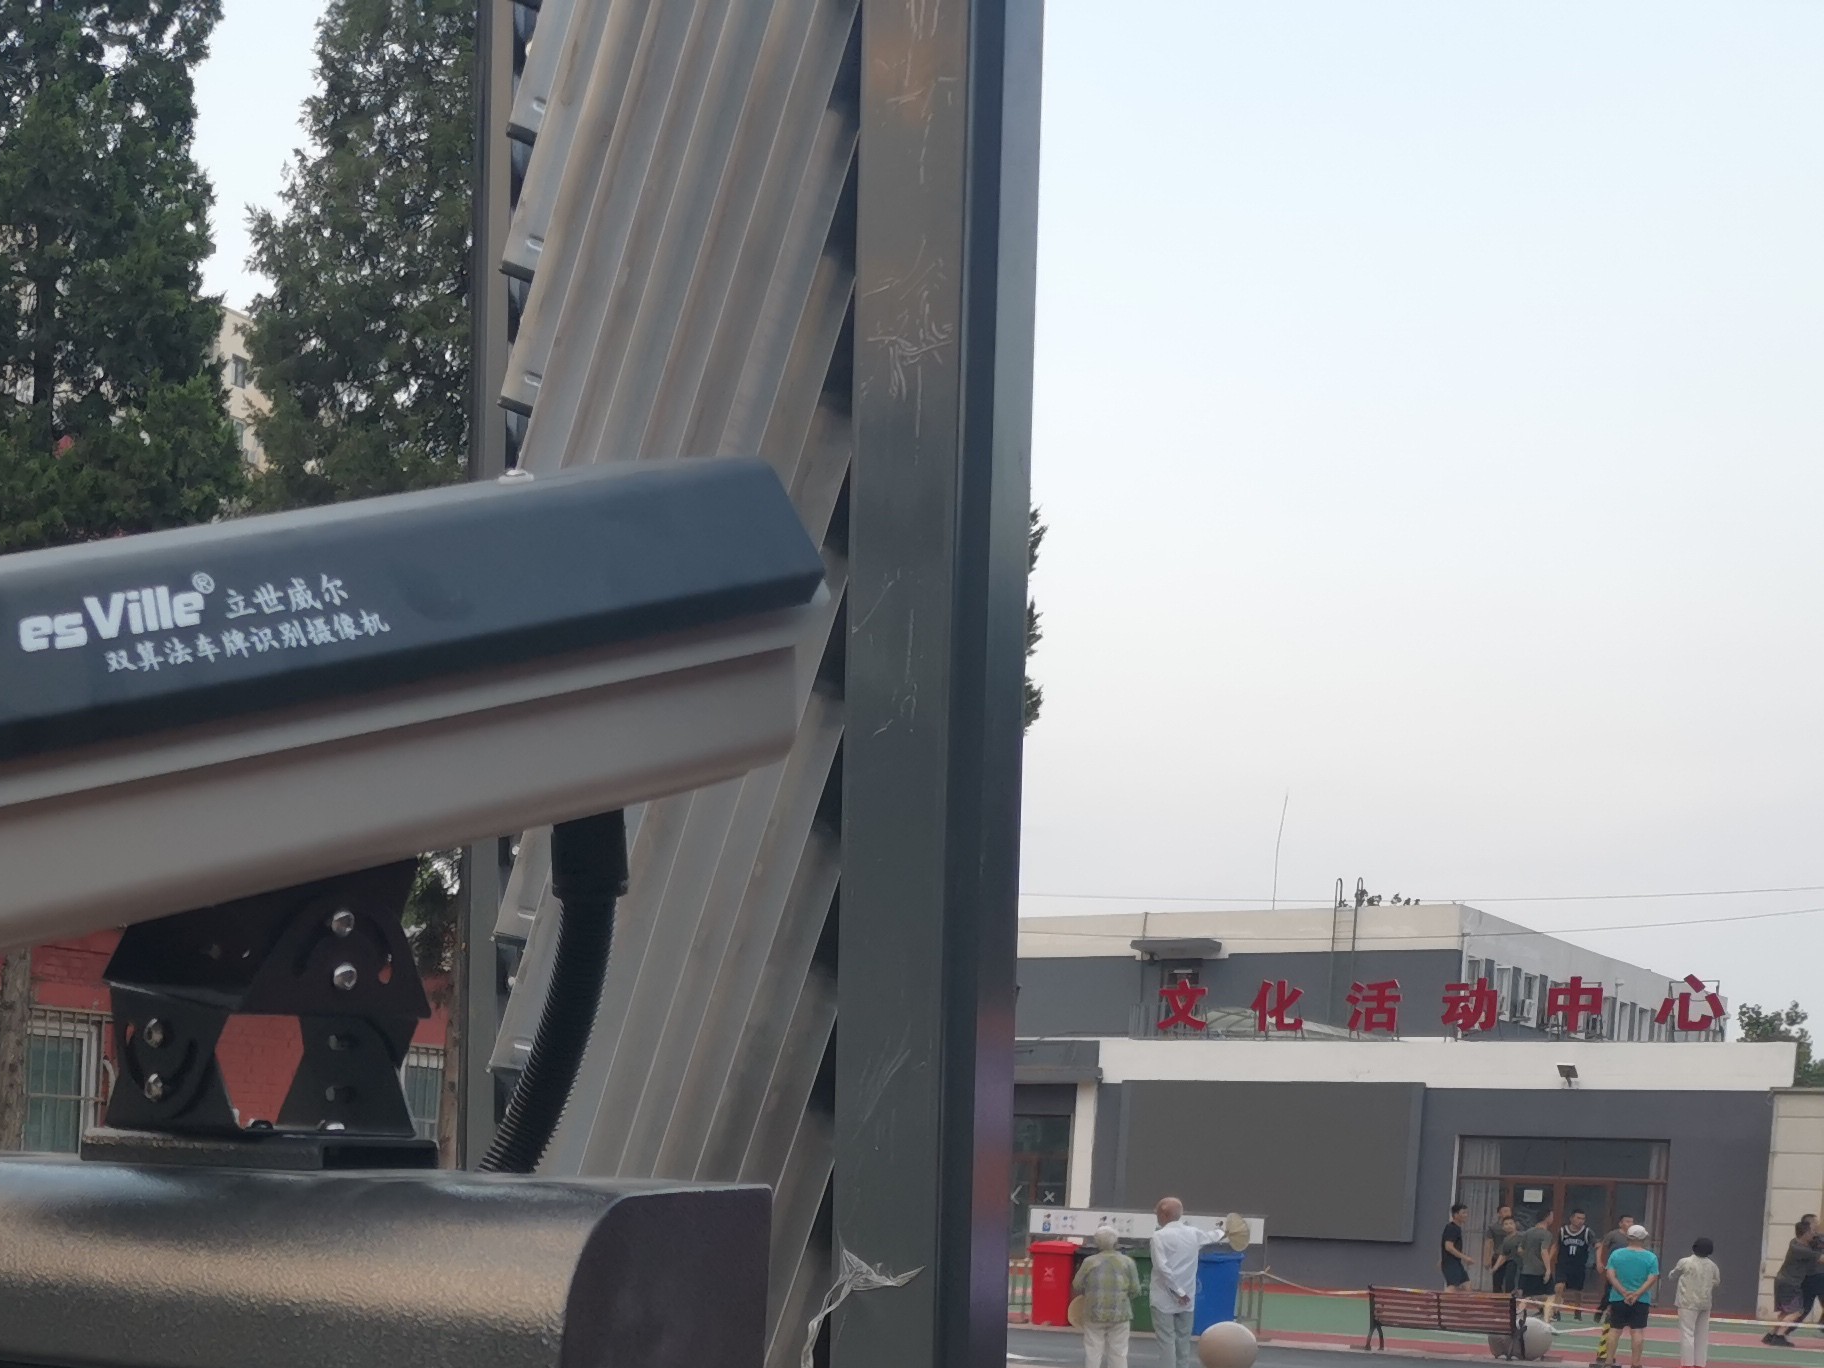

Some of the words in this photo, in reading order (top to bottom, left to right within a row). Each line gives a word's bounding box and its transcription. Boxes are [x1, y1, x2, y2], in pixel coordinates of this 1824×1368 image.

[225, 573, 349, 619] 立世威尔
[104, 608, 391, 673] 双算法车牌识别摄像机
[1156, 974, 1726, 1034] 文化活动中心
